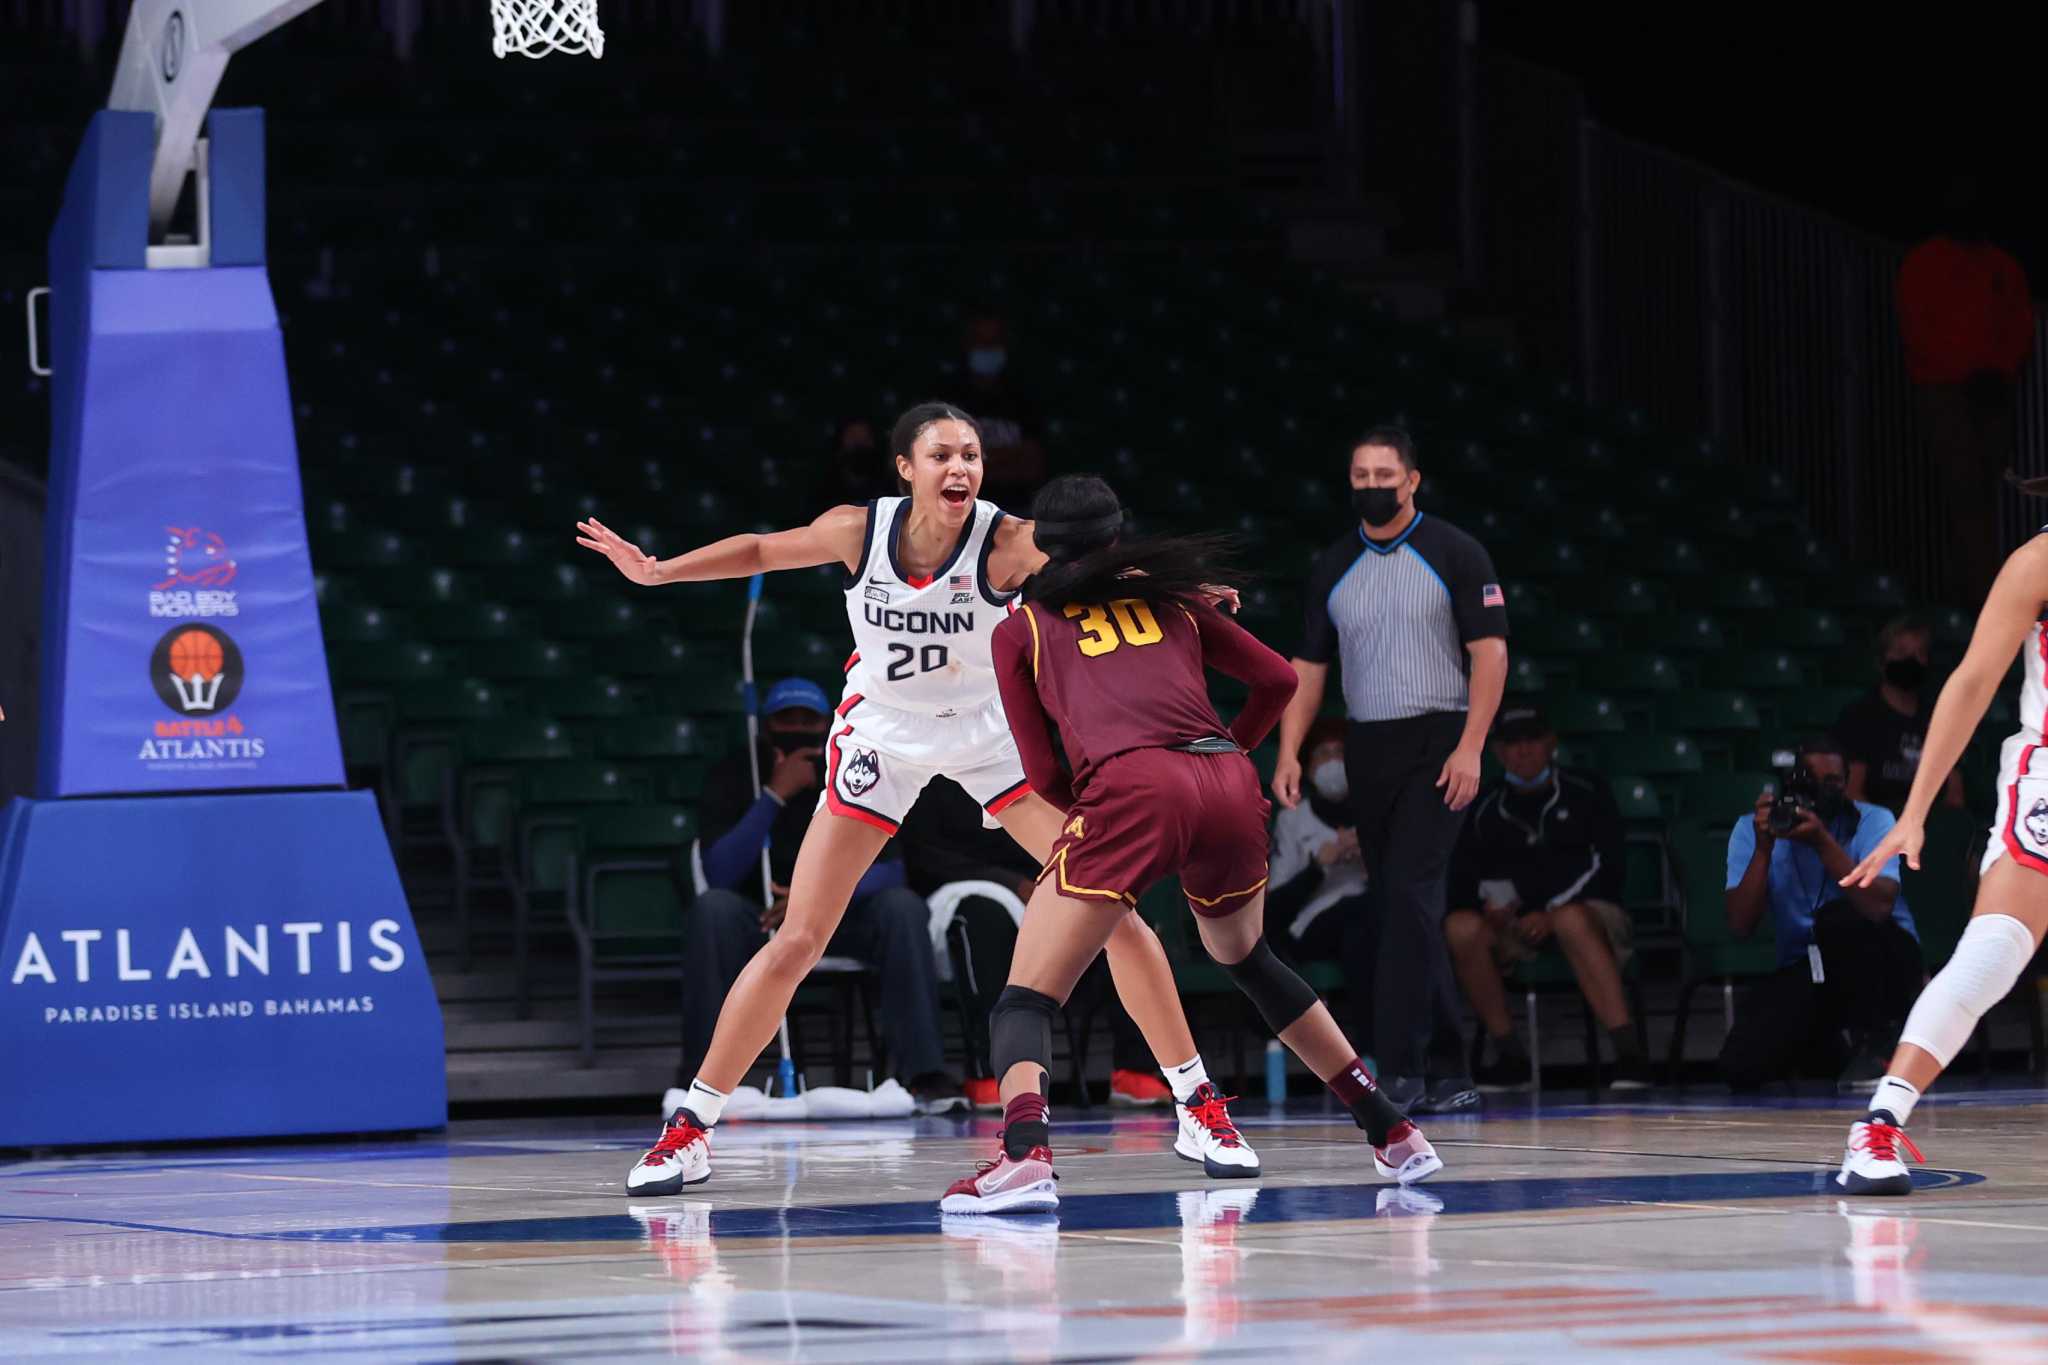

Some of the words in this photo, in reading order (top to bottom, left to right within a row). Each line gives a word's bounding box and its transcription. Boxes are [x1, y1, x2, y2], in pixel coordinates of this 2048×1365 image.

[864, 602, 974, 634] UCONN
[1063, 598, 1165, 658] 30
[887, 643, 948, 681] 20
[139, 739, 265, 760] ATLANTIS
[11, 918, 406, 985] ATLANTIS
[44, 1003, 159, 1024] PARADISE
[169, 1000, 254, 1020] ISLAND
[265, 996, 375, 1016] BAHAMAS
